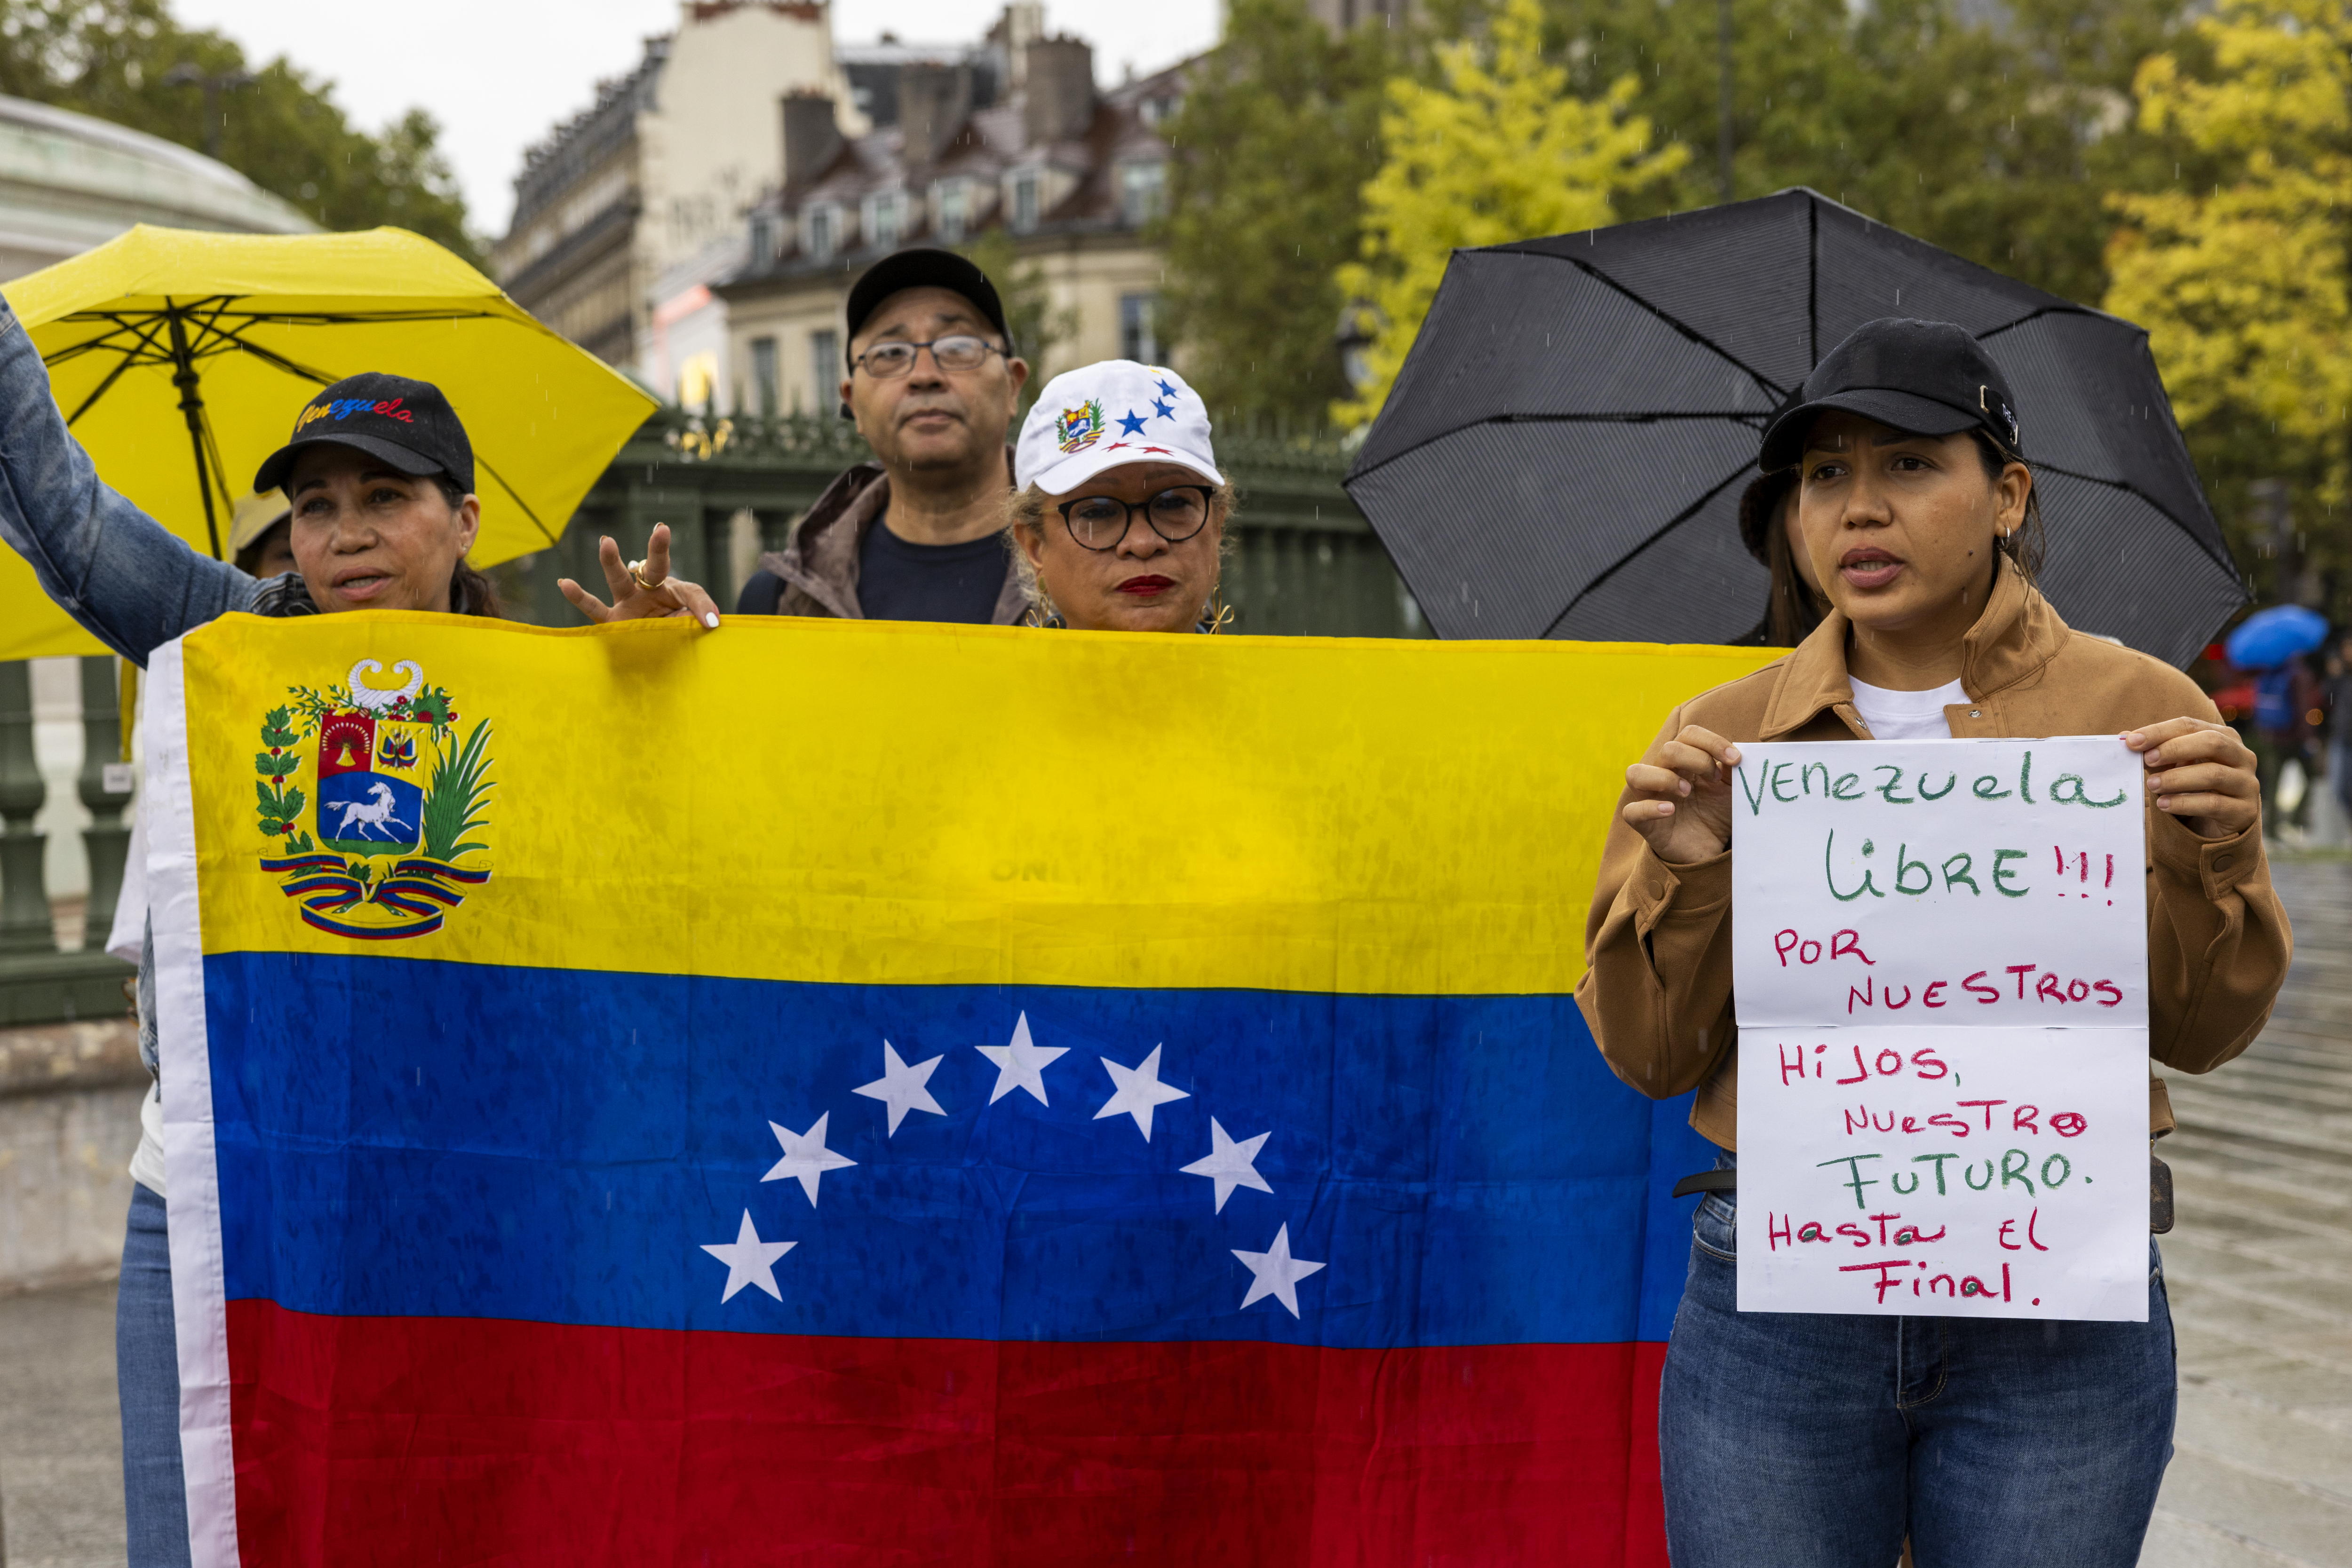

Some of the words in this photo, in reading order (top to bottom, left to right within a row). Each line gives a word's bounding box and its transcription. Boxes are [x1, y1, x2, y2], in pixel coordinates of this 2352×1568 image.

[1773, 928, 1876, 967] POR
[1848, 963, 2123, 1014] NUESTROS
[1838, 1260, 2041, 1307] Final.
